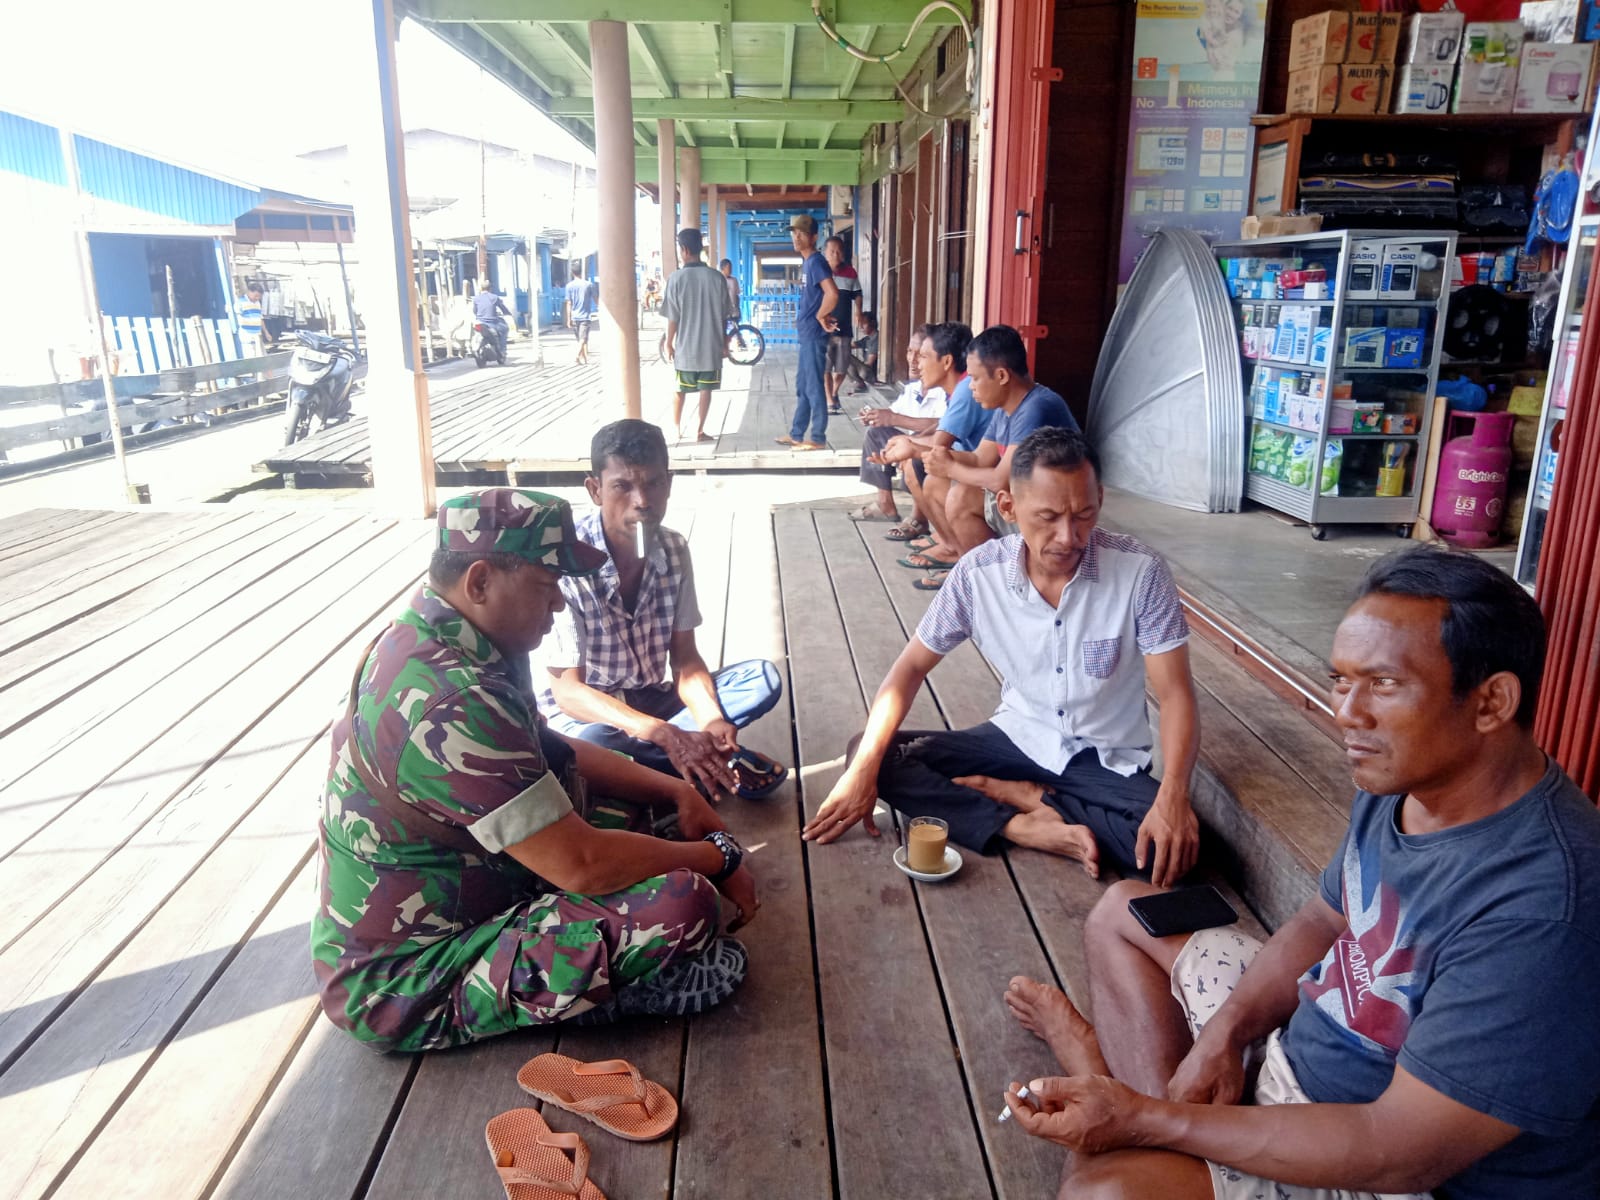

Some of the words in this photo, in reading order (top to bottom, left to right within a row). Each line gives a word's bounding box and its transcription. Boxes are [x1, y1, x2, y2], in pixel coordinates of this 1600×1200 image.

[1355, 16, 1378, 26] MULT
[1347, 68, 1373, 78] MULTI
[1136, 98, 1155, 108] No
[1162, 64, 1182, 108] 1
[1187, 84, 1238, 96] Memory
[1187, 97, 1246, 108] Indonesia
[1348, 943, 1372, 1006] BROMPTO
